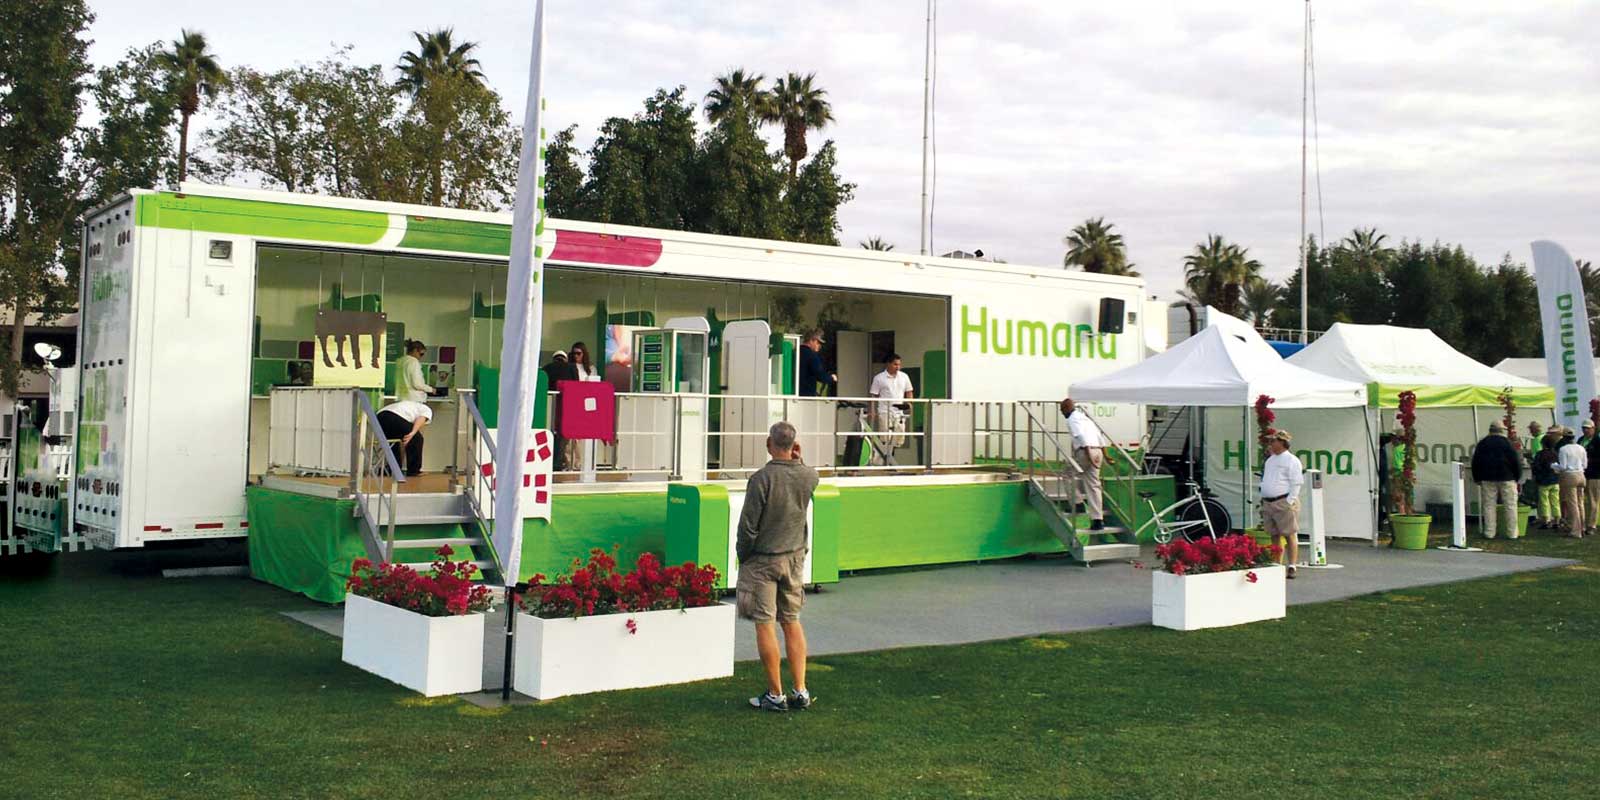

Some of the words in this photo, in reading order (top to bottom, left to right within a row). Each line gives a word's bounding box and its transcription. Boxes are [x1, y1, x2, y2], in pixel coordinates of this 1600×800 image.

[961, 304, 1117, 360] Humana
[1556, 293, 1579, 417] Humana
[1223, 440, 1354, 476] Huana
